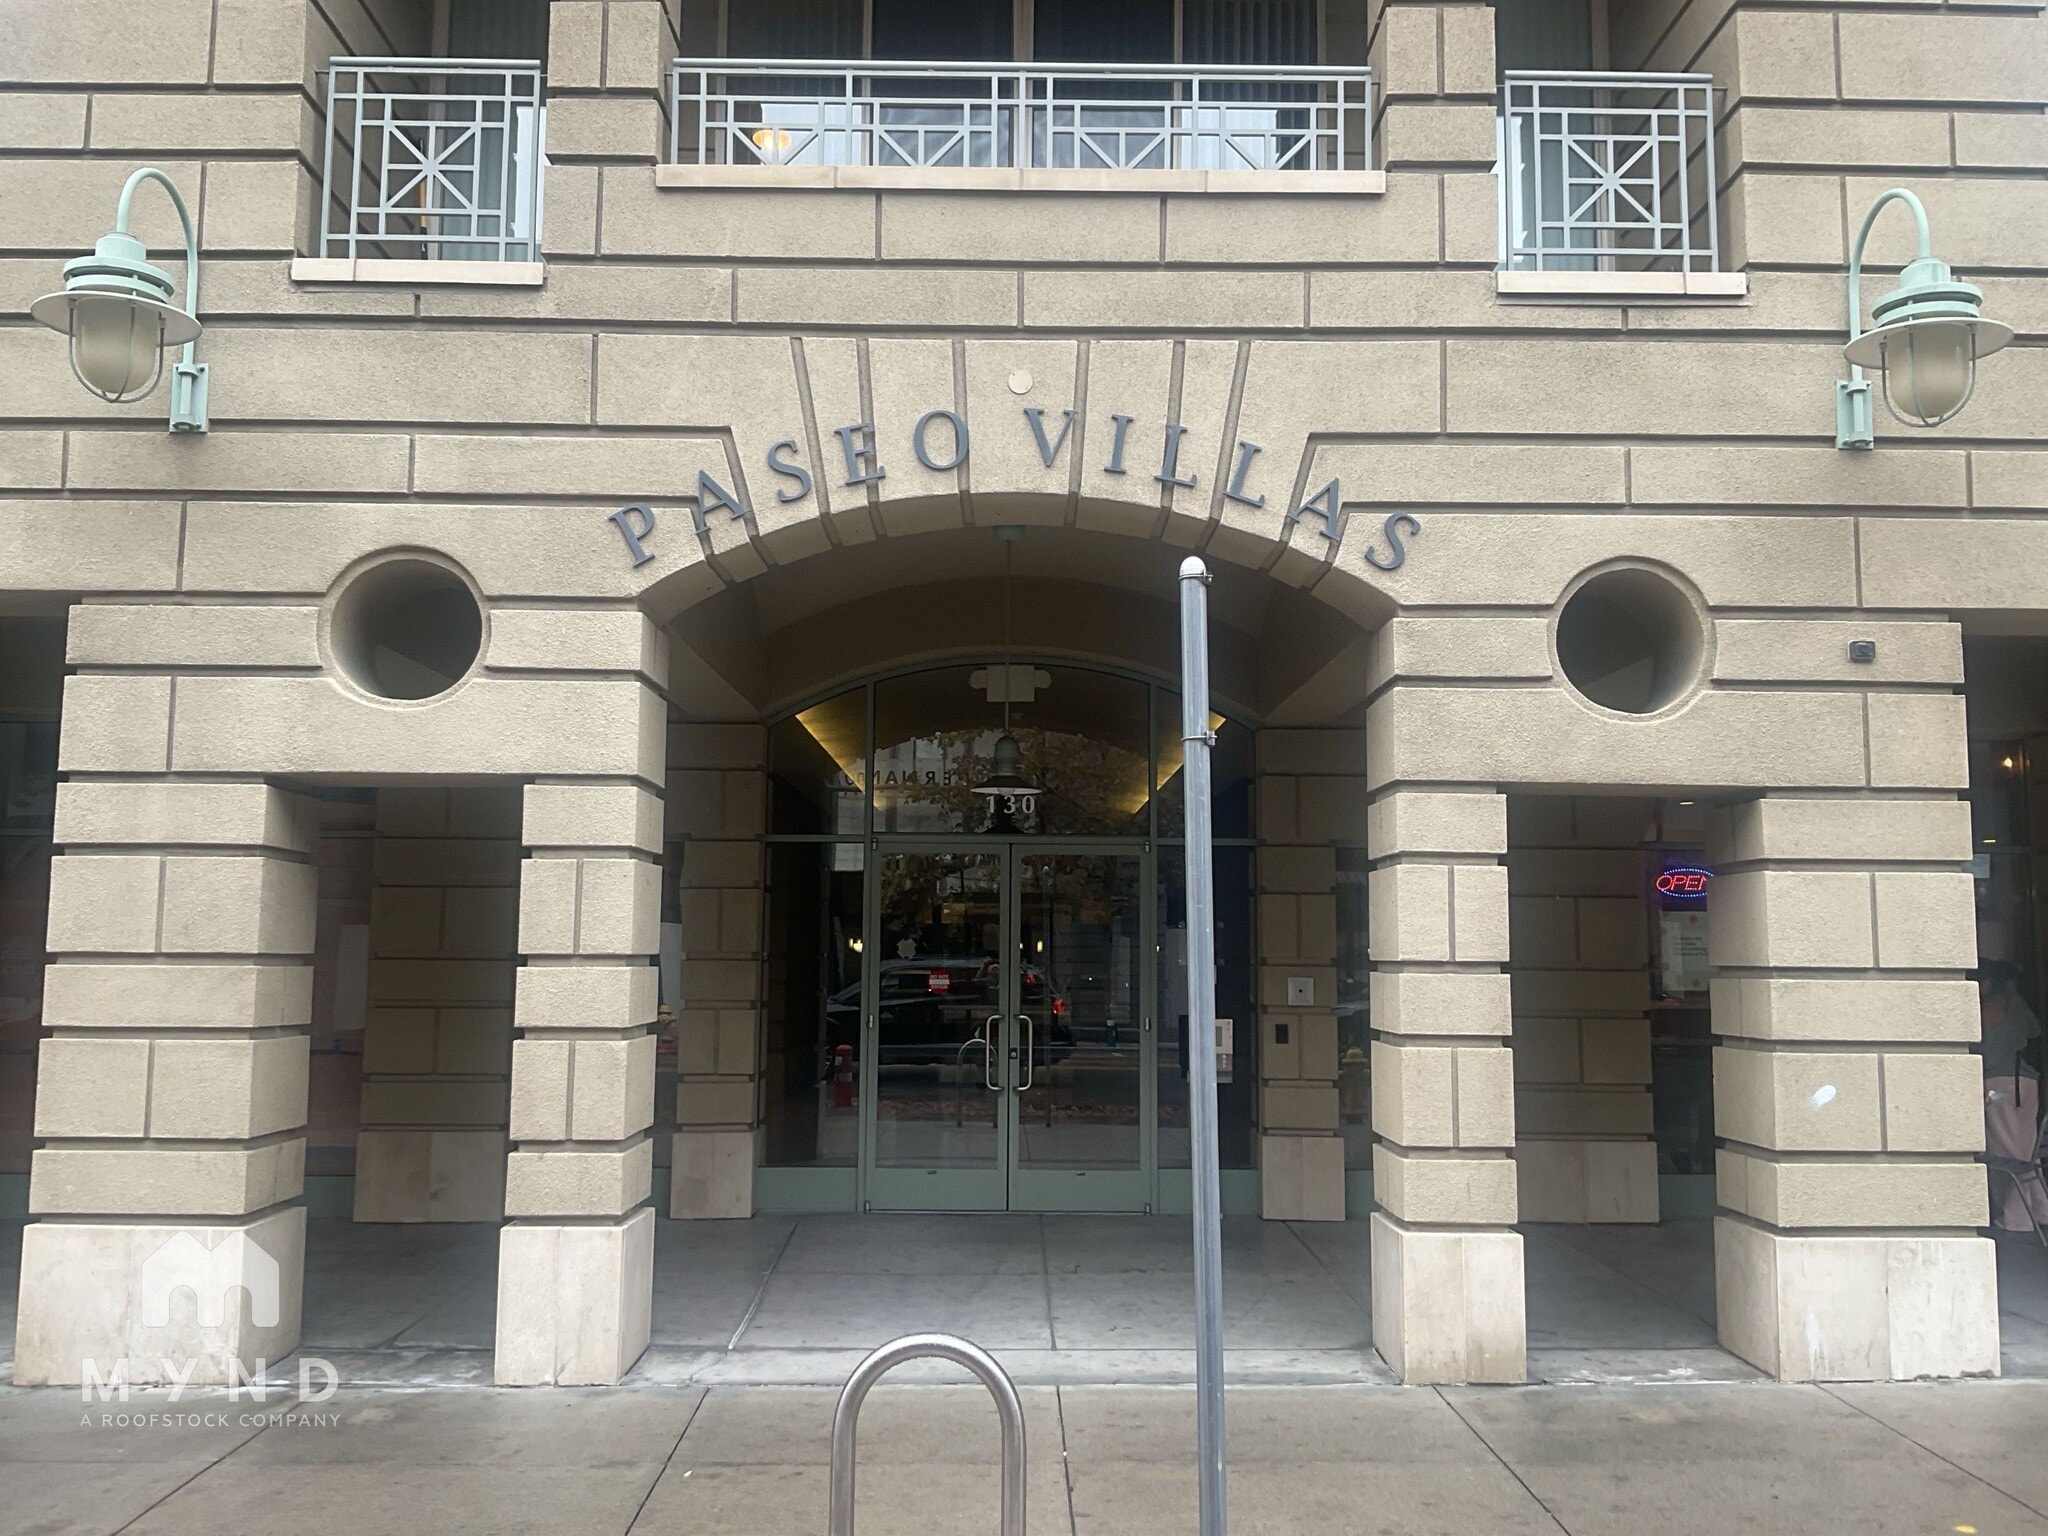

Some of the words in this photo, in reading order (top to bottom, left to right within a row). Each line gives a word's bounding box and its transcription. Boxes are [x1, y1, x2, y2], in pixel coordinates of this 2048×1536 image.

[607, 409, 971, 568] PASEO
[1023, 407, 1421, 570] VILLAS
[986, 794, 1035, 814] 130
